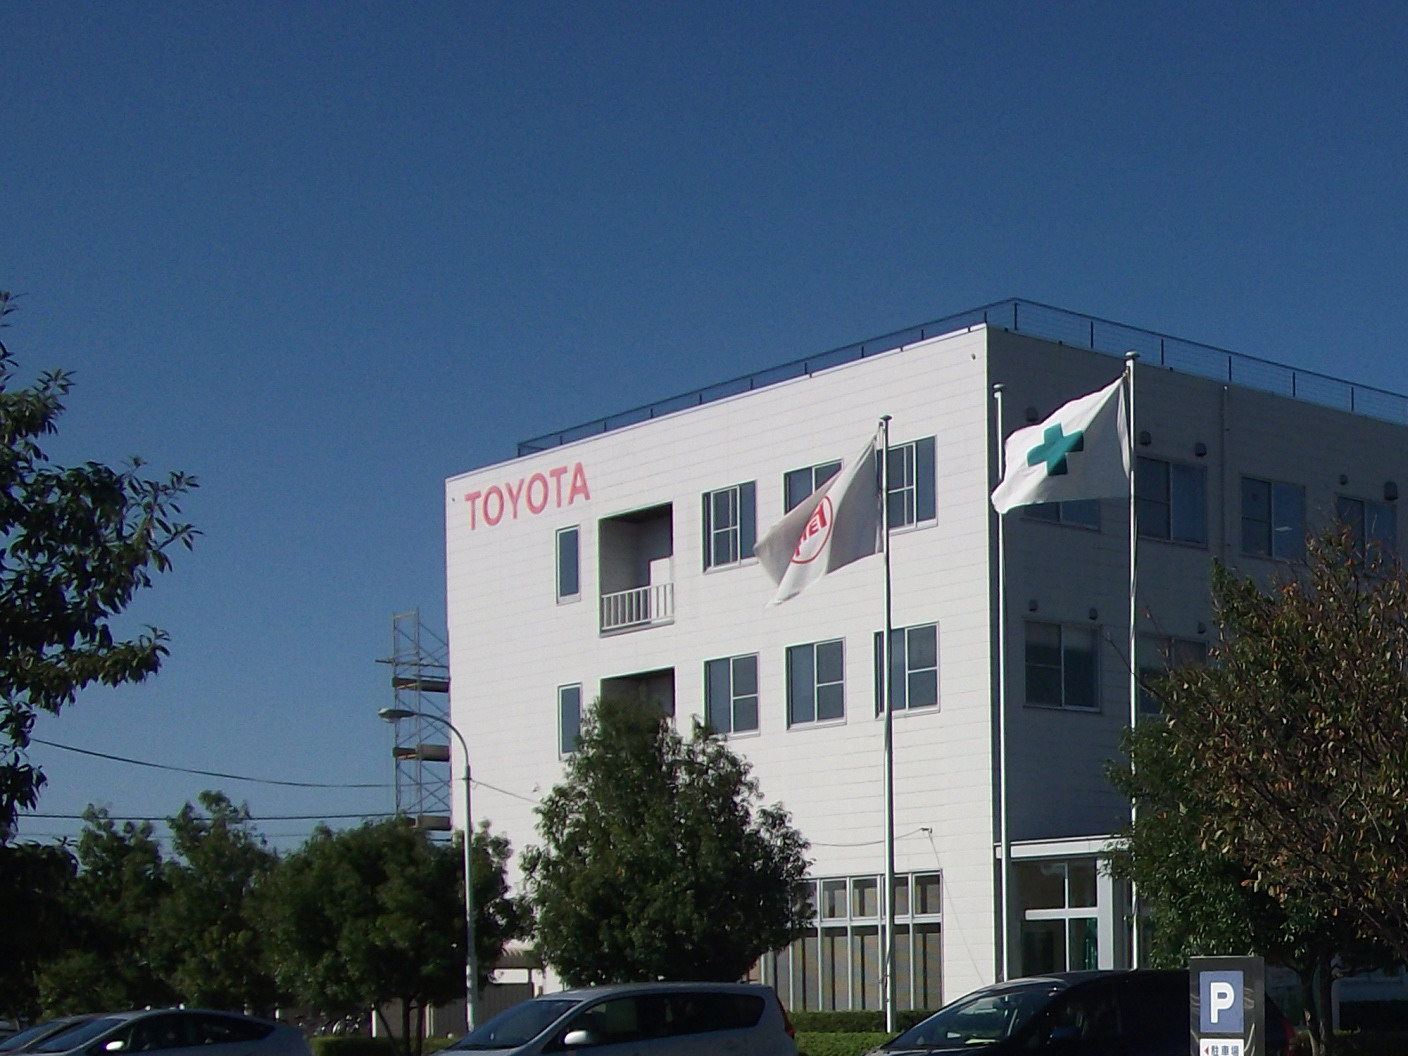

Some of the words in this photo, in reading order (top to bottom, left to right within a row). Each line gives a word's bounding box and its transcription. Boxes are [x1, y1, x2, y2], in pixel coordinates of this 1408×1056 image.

[464, 462, 591, 531] TOYOTA
[1210, 982, 1235, 1023] P
[1211, 1045, 1239, 1056] 駐車場
